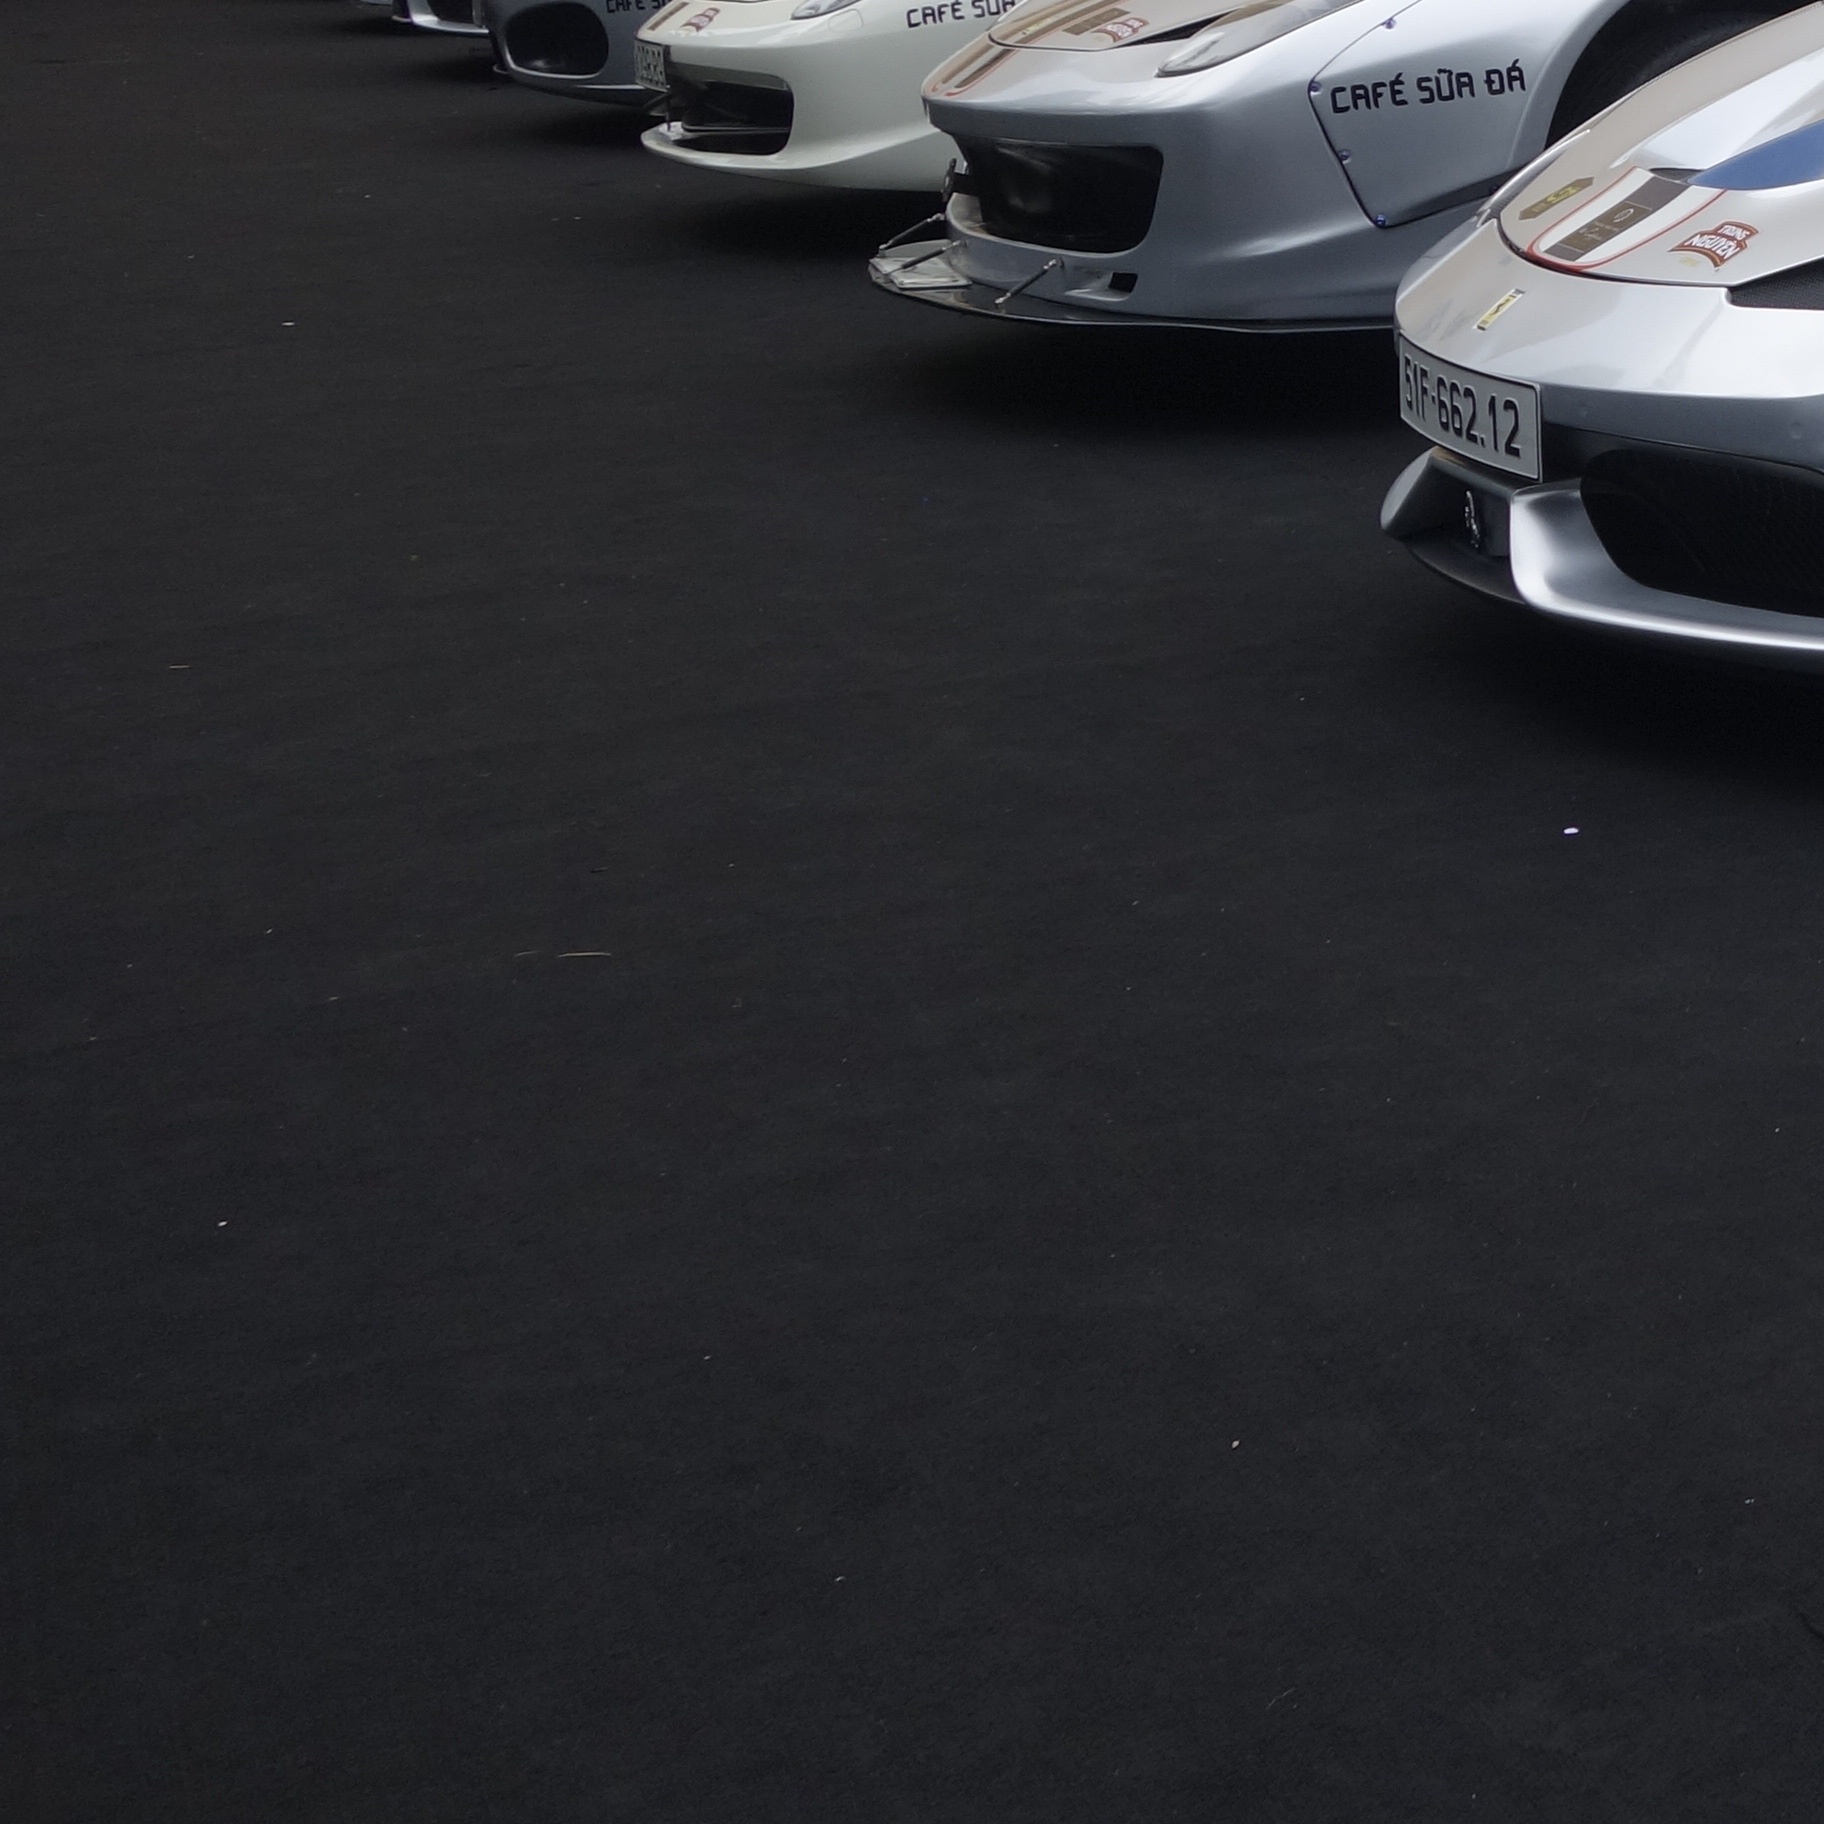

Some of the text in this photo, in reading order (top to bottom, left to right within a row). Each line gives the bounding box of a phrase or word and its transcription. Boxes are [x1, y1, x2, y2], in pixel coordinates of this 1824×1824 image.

[1330, 58, 1526, 114] CAFÉ SỮA ĐÁ
[1404, 353, 1521, 459] 51F-662.12
